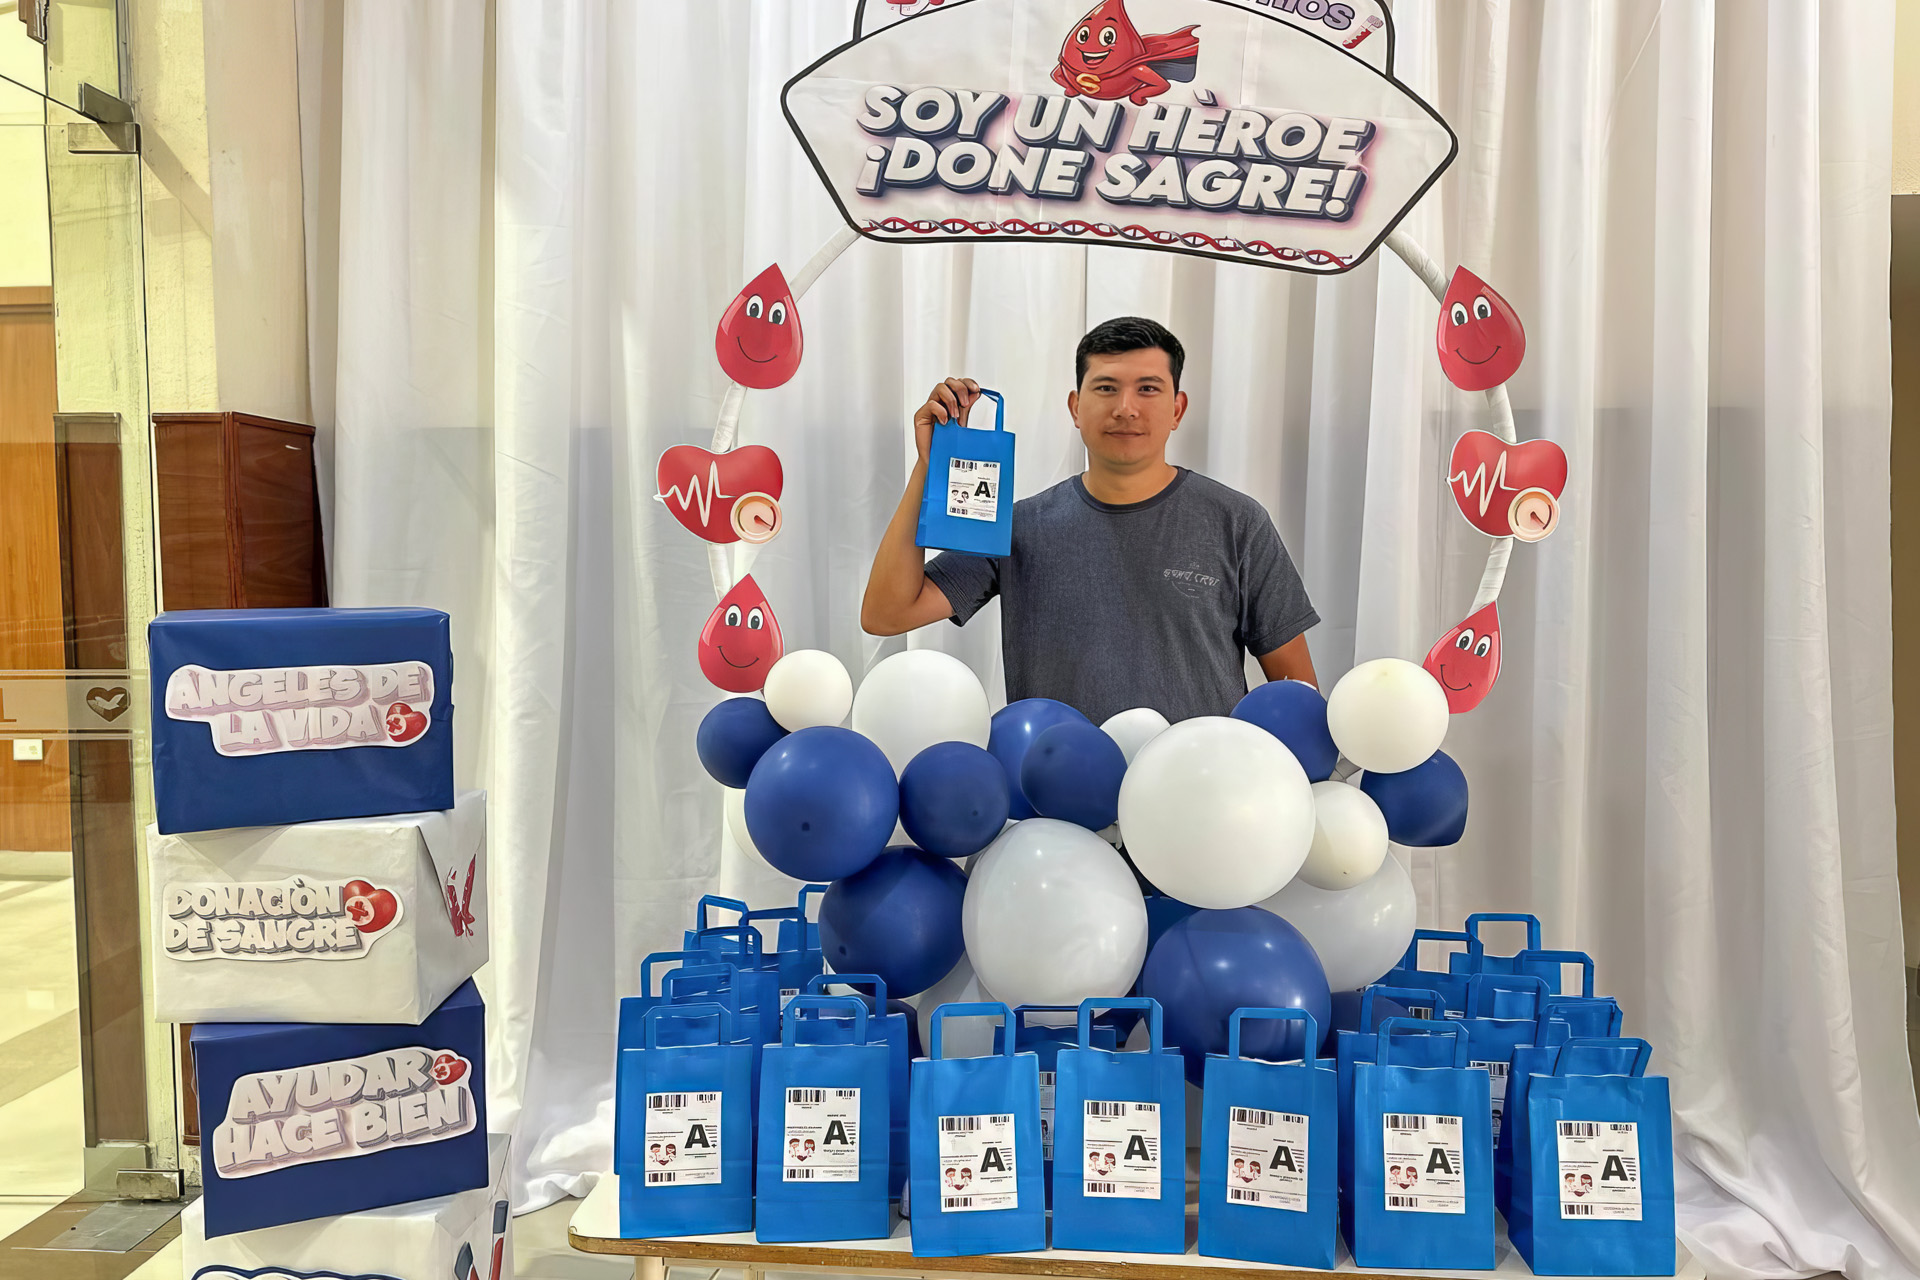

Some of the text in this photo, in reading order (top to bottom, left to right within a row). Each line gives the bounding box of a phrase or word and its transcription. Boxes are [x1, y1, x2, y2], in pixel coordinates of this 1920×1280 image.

[856, 85, 1008, 141] SOY
[1013, 94, 1125, 153] UN
[856, 136, 1367, 222] ¡DONE SAGRE!
[168, 665, 431, 717] ANGELES DE
[219, 704, 388, 751] LA VIDA
[166, 917, 363, 954] DE SANGRE
[231, 1050, 437, 1125] AYUDAR
[215, 1085, 468, 1174] HACE BIEN
